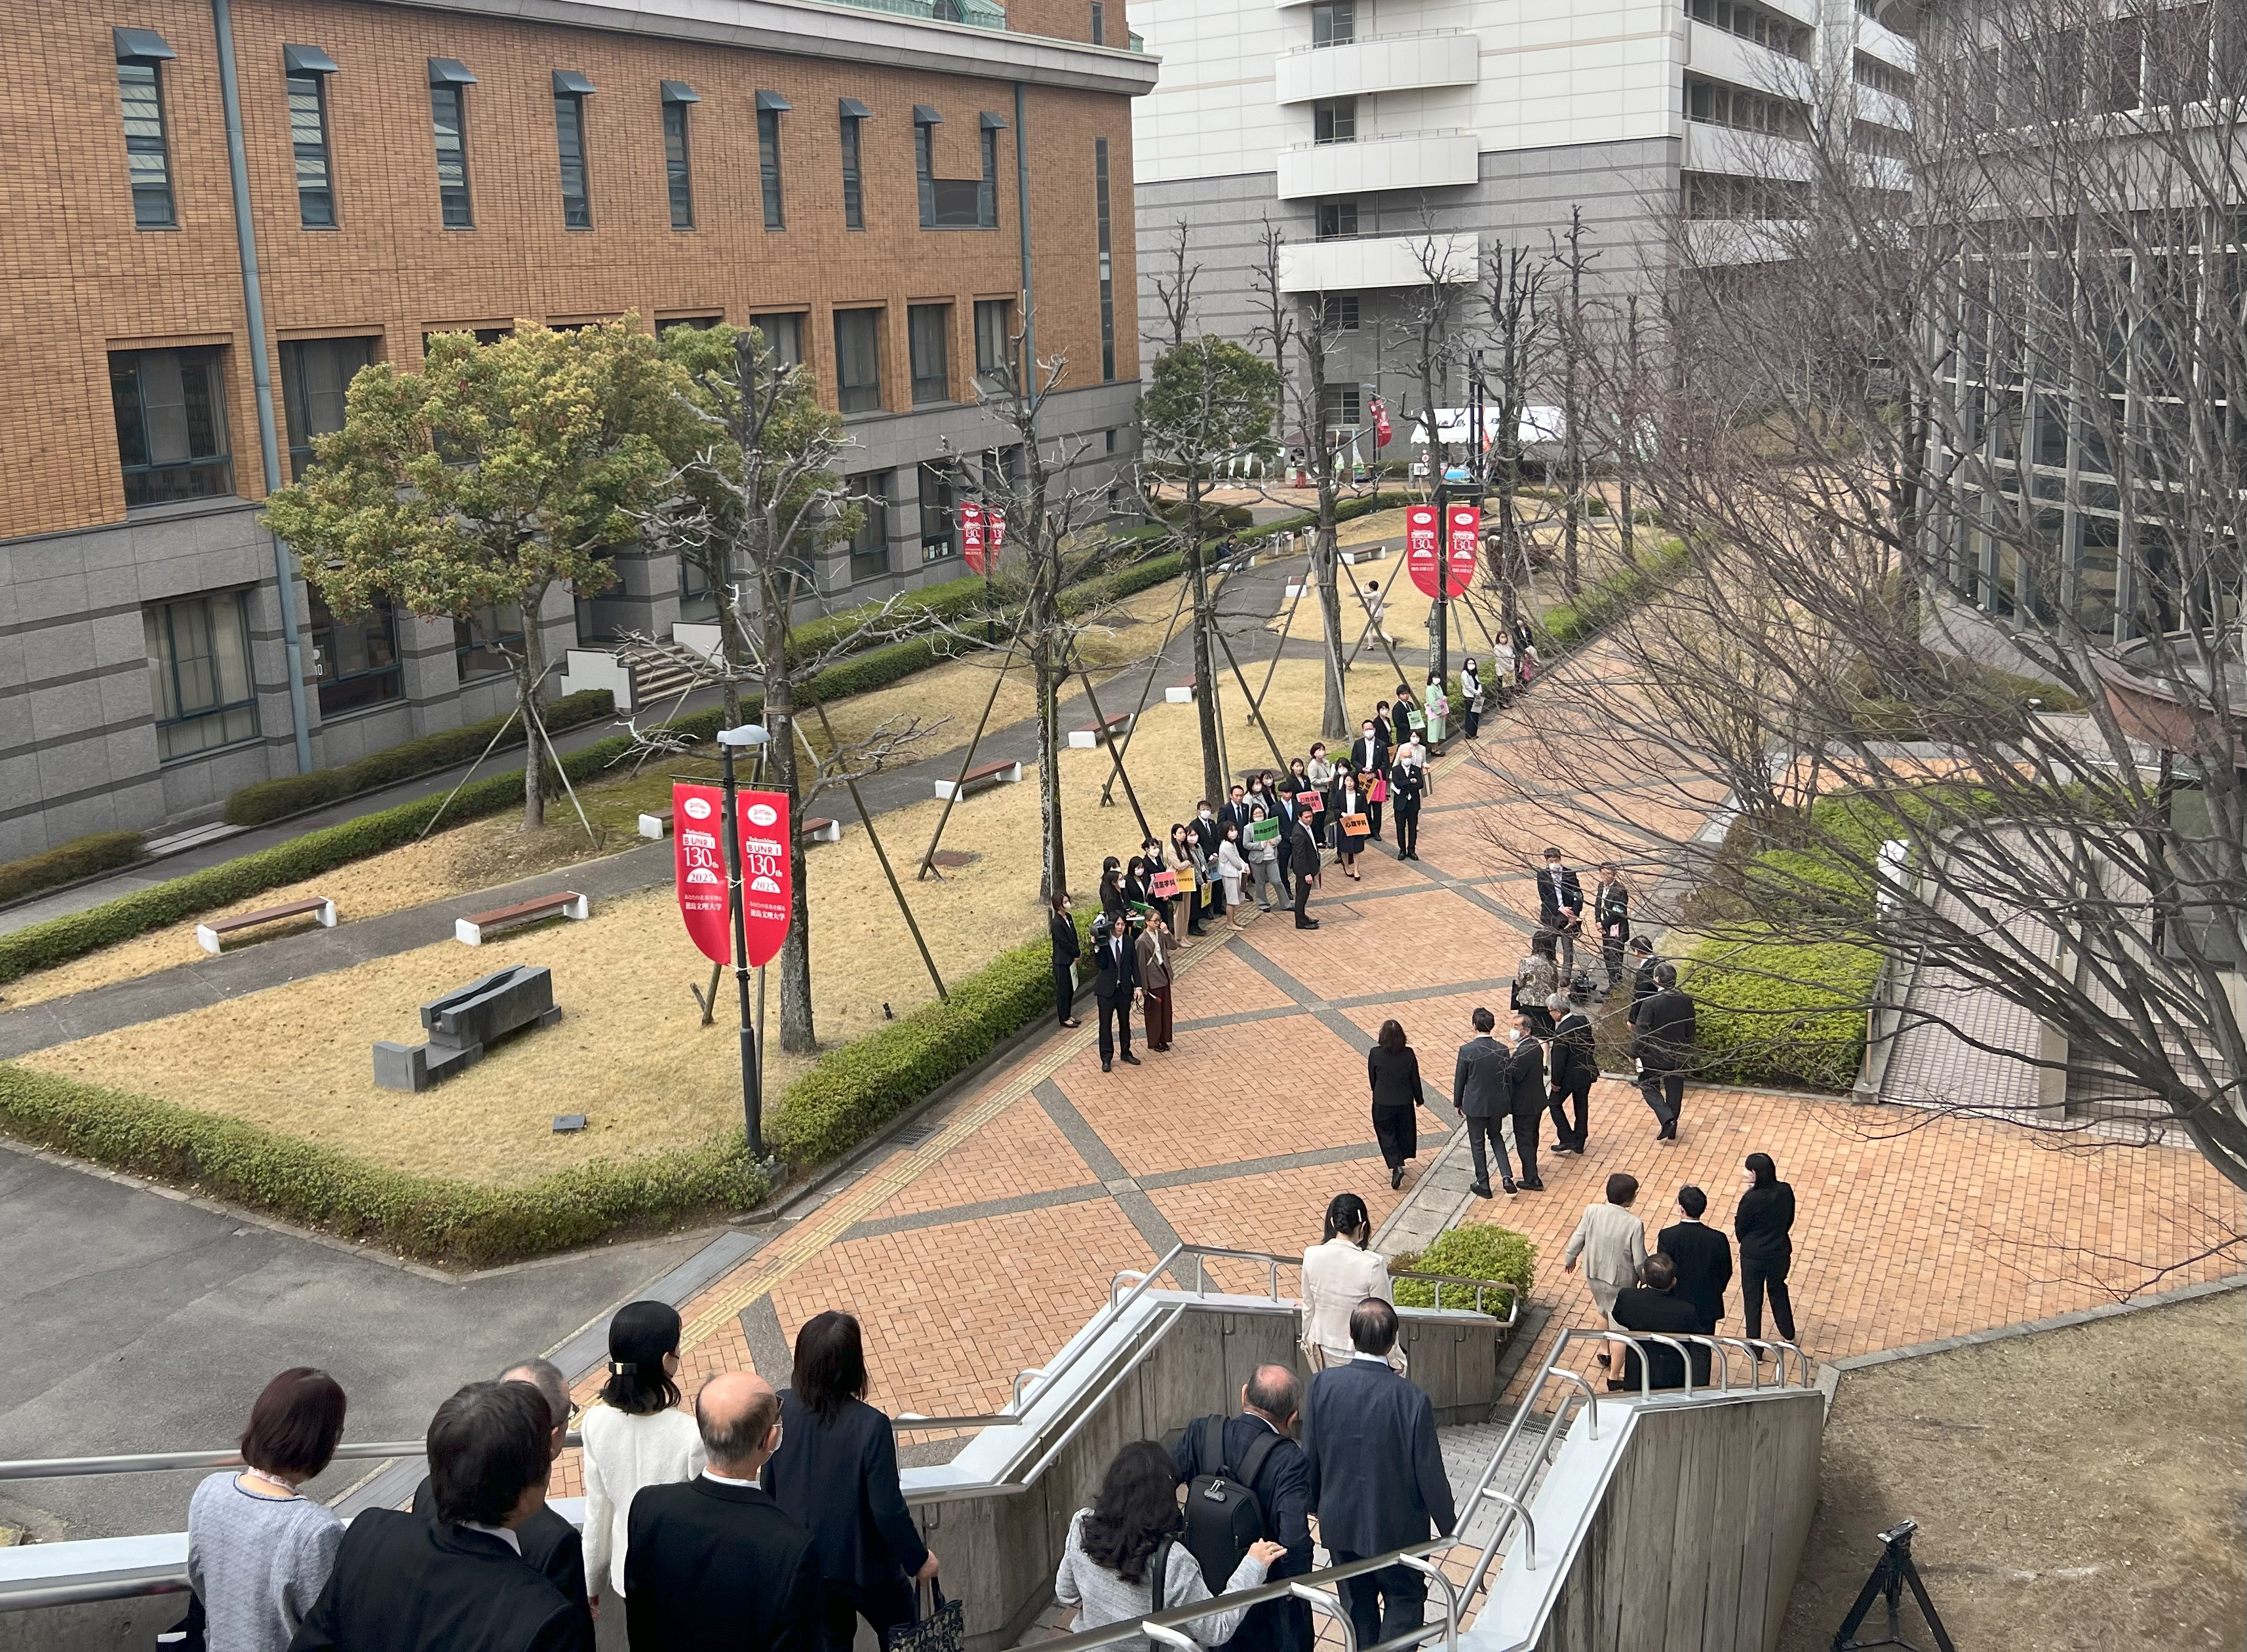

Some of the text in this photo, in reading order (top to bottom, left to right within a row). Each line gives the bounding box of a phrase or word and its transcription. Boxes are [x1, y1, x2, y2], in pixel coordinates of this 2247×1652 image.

[1346, 819, 1367, 828] 心理学科
[685, 828, 712, 837] Tokushima
[684, 837, 713, 848] BUNRI
[748, 836, 777, 845] Tokushima
[749, 844, 779, 855] BUNRI
[690, 873, 714, 883] 2025
[755, 881, 775, 892] 2025
